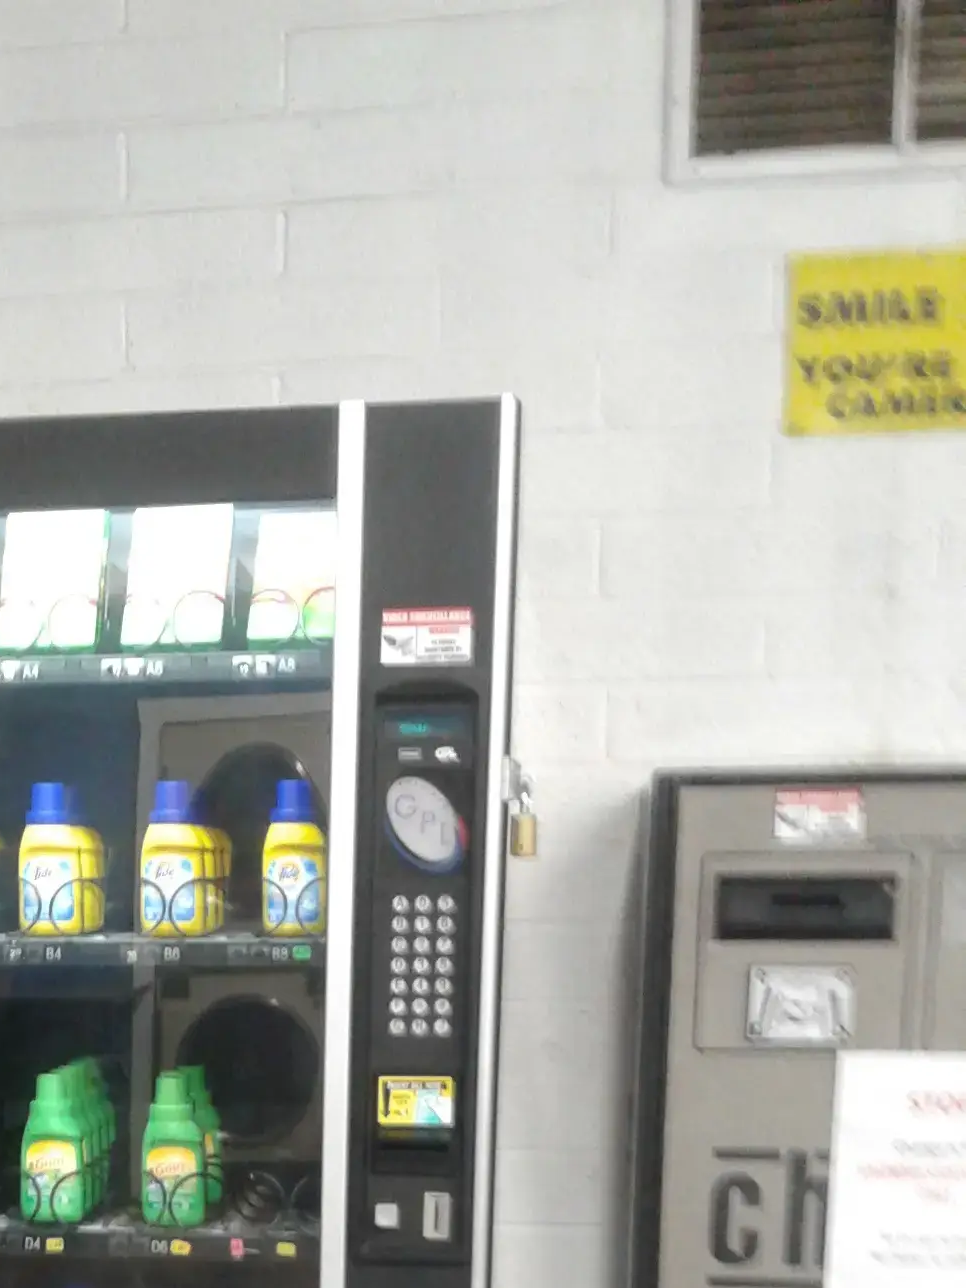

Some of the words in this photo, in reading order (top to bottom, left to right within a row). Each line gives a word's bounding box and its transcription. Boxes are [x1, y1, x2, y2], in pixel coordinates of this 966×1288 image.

[797, 287, 942, 329] SMILE
[22, 661, 40, 680] A4
[45, 945, 62, 961] B4
[24, 1236, 42, 1251] D4
